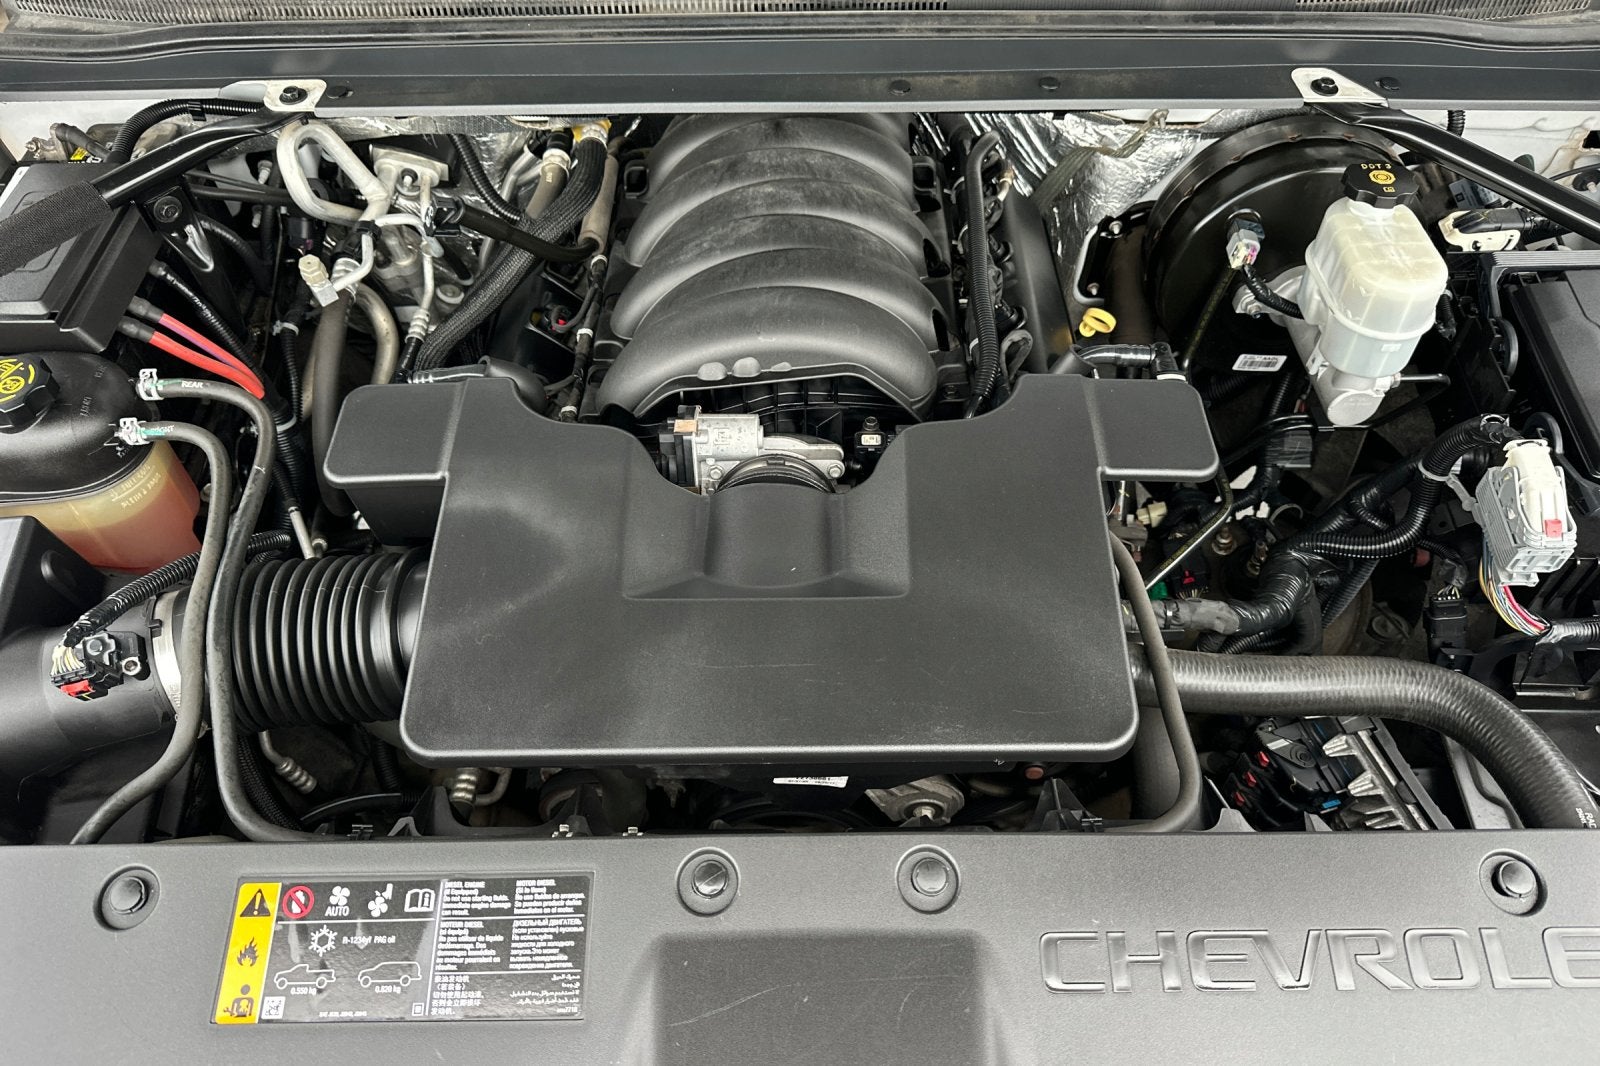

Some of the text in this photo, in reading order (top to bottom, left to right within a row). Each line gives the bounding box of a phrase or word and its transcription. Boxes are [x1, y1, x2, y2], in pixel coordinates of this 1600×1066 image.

[181, 380, 203, 388] REAR
[325, 905, 350, 917] AUTO
[374, 935, 387, 944] PAG
[387, 935, 396, 944] oil
[308, 987, 317, 996] kg
[393, 985, 401, 994] kg
